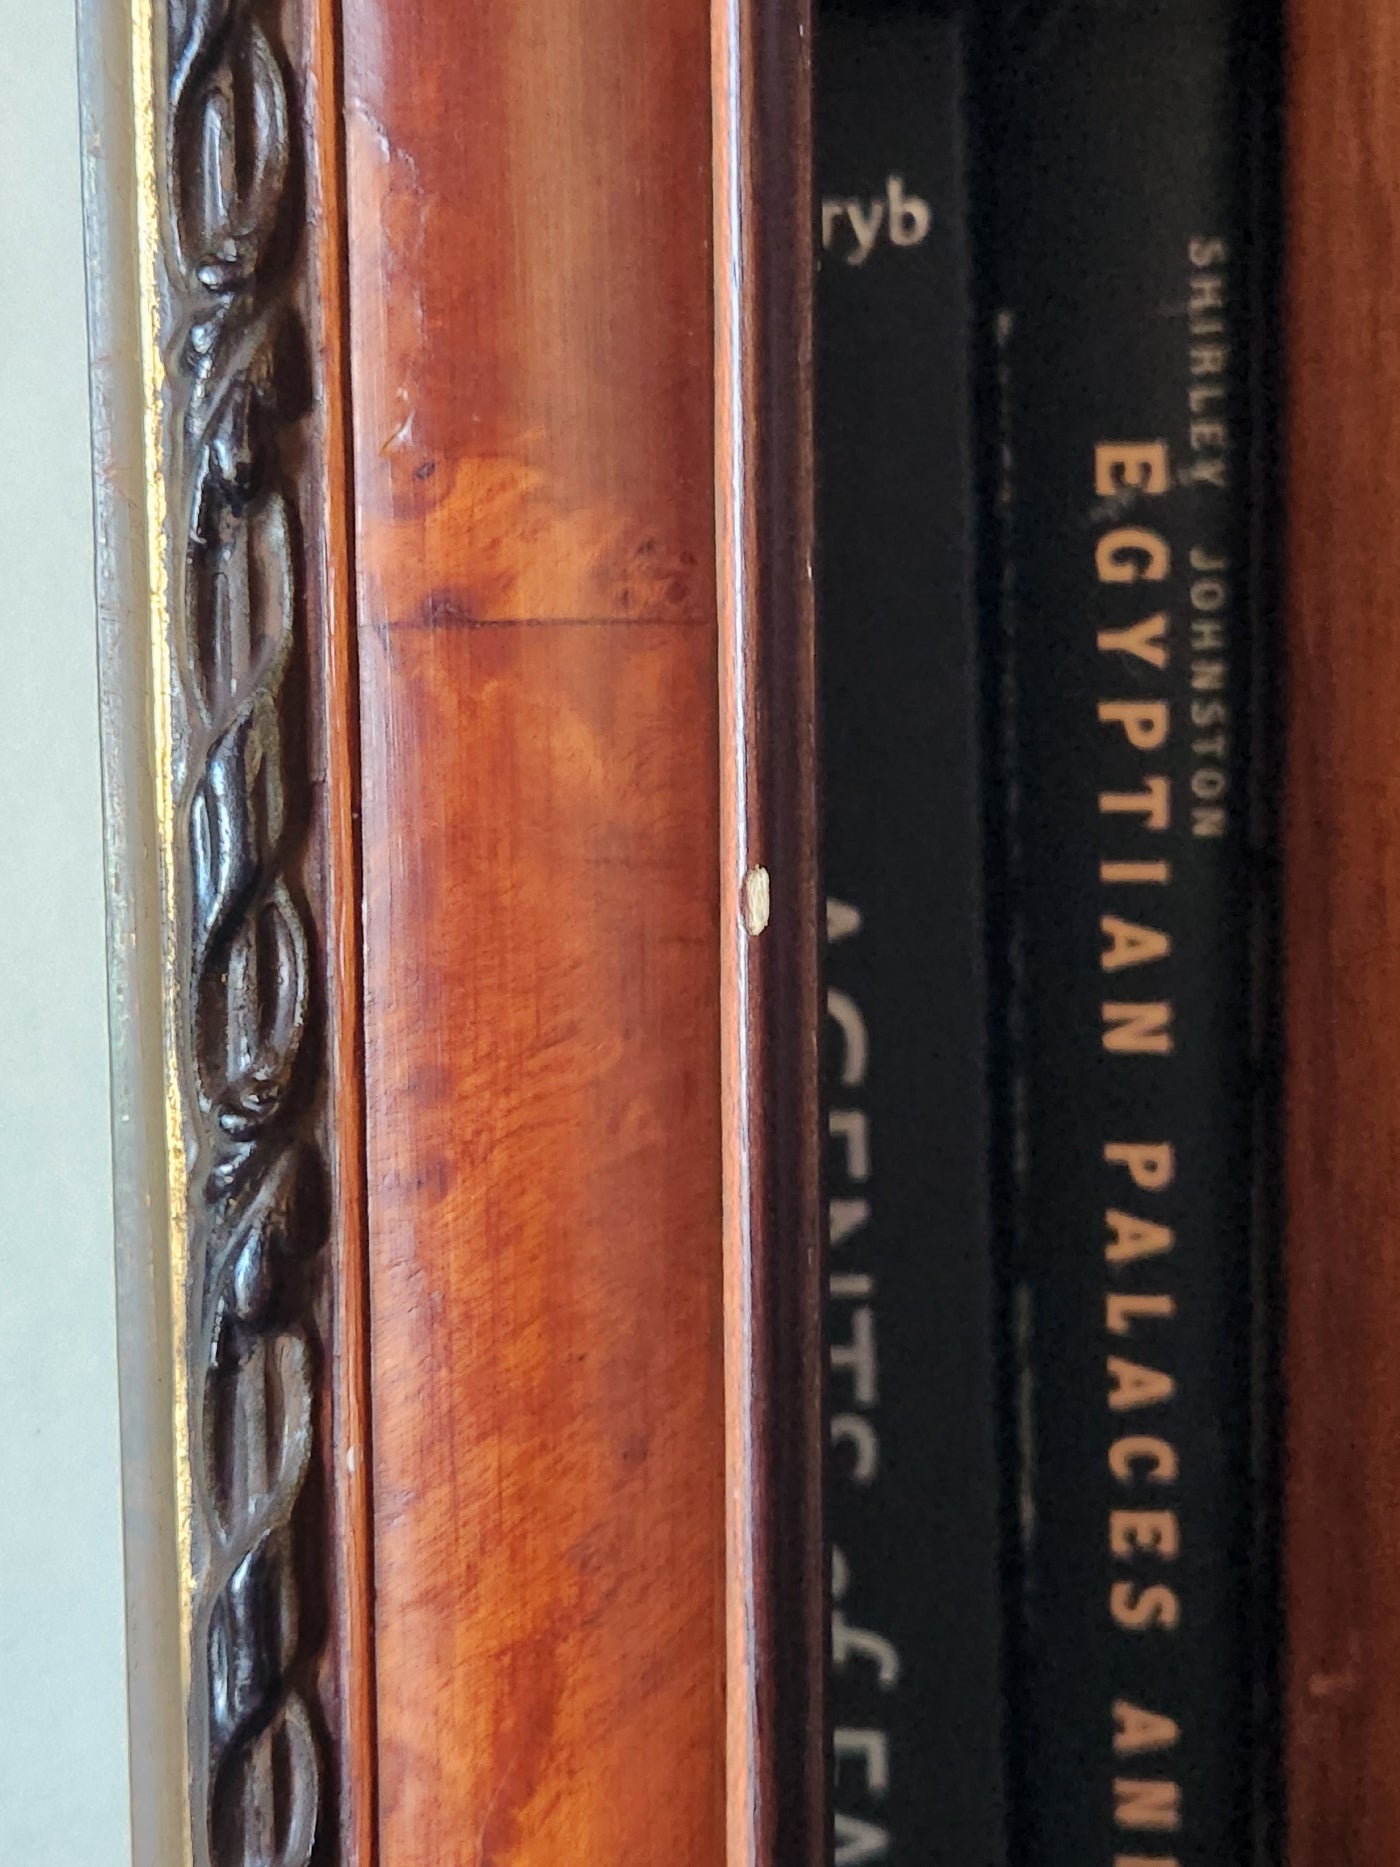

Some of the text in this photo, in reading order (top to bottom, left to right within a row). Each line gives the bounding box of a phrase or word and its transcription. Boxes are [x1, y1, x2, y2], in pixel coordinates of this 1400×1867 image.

[1189, 238, 1227, 838] SHIRLEY JOHNSTON
[1095, 441, 1179, 1867] EGYPTIAN PALACES AN
